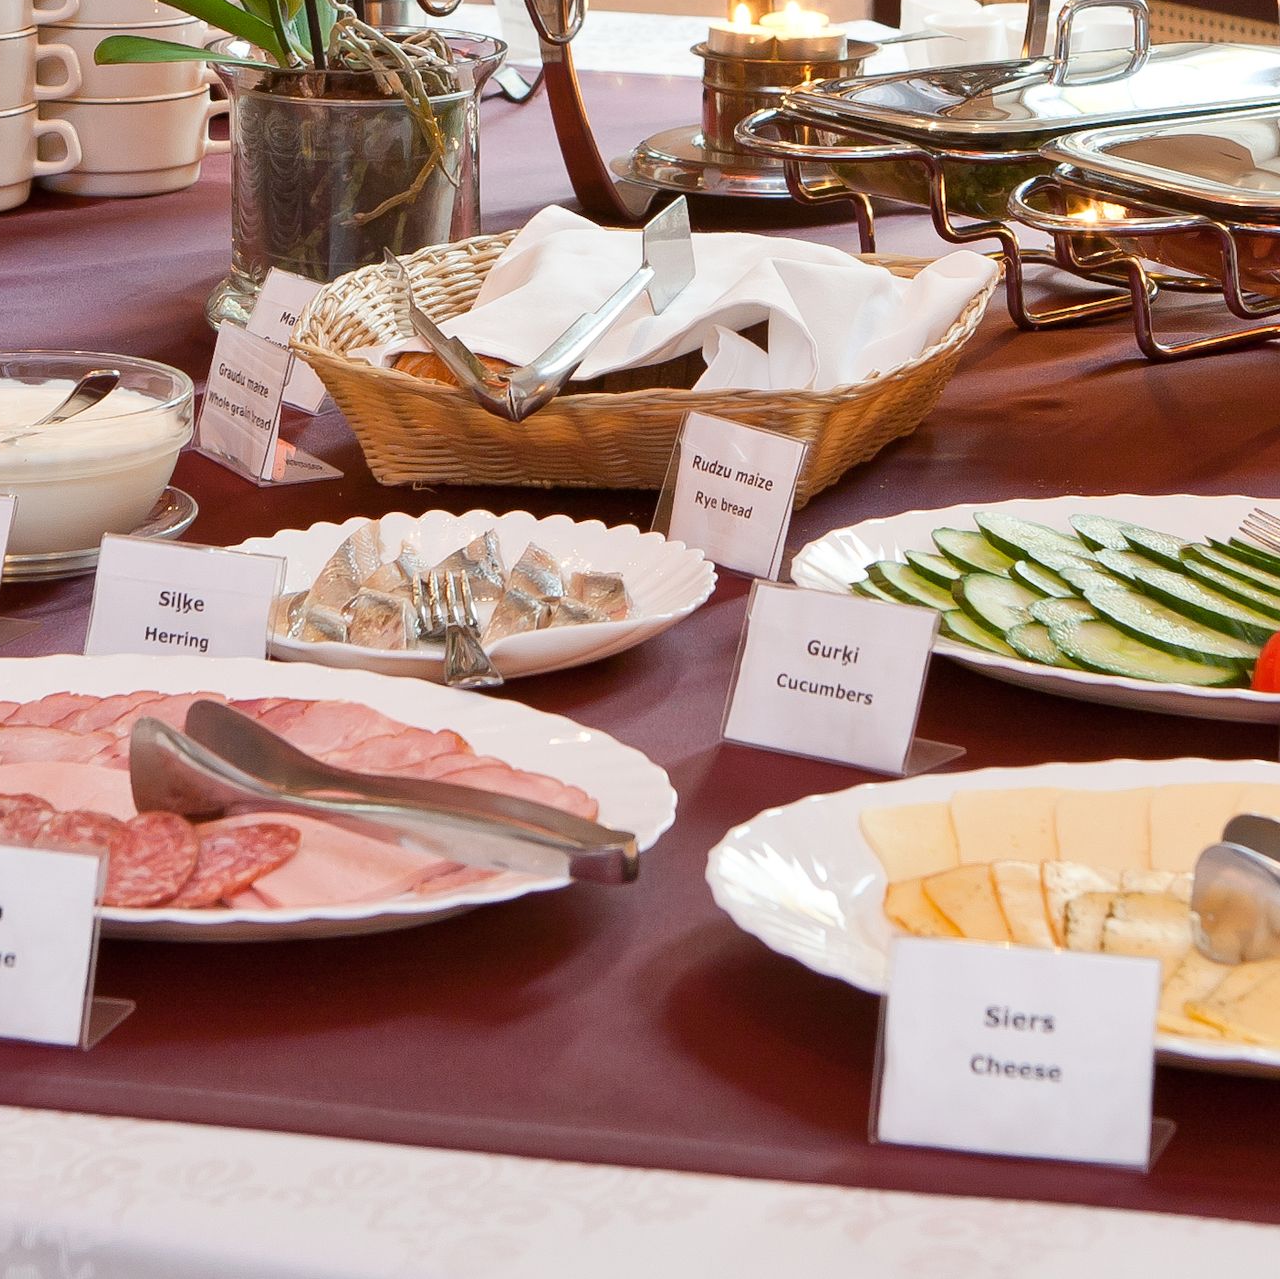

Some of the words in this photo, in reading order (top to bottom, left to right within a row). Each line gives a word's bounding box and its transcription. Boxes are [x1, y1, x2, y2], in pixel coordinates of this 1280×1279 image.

[219, 363, 246, 386] Graudu
[247, 378, 269, 398] maize
[209, 390, 230, 410] Whole
[231, 404, 251, 417] grain
[692, 455, 732, 480] Rudzu
[735, 469, 774, 492] maize
[694, 491, 717, 510] Rye
[721, 497, 754, 520] bread
[158, 591, 205, 614] Siļķe
[144, 626, 210, 653] Herring
[807, 640, 860, 666] Gurķi
[776, 673, 874, 706] Cucumbers
[984, 1005, 1056, 1034] Siers
[970, 1054, 1063, 1082] Cheese
